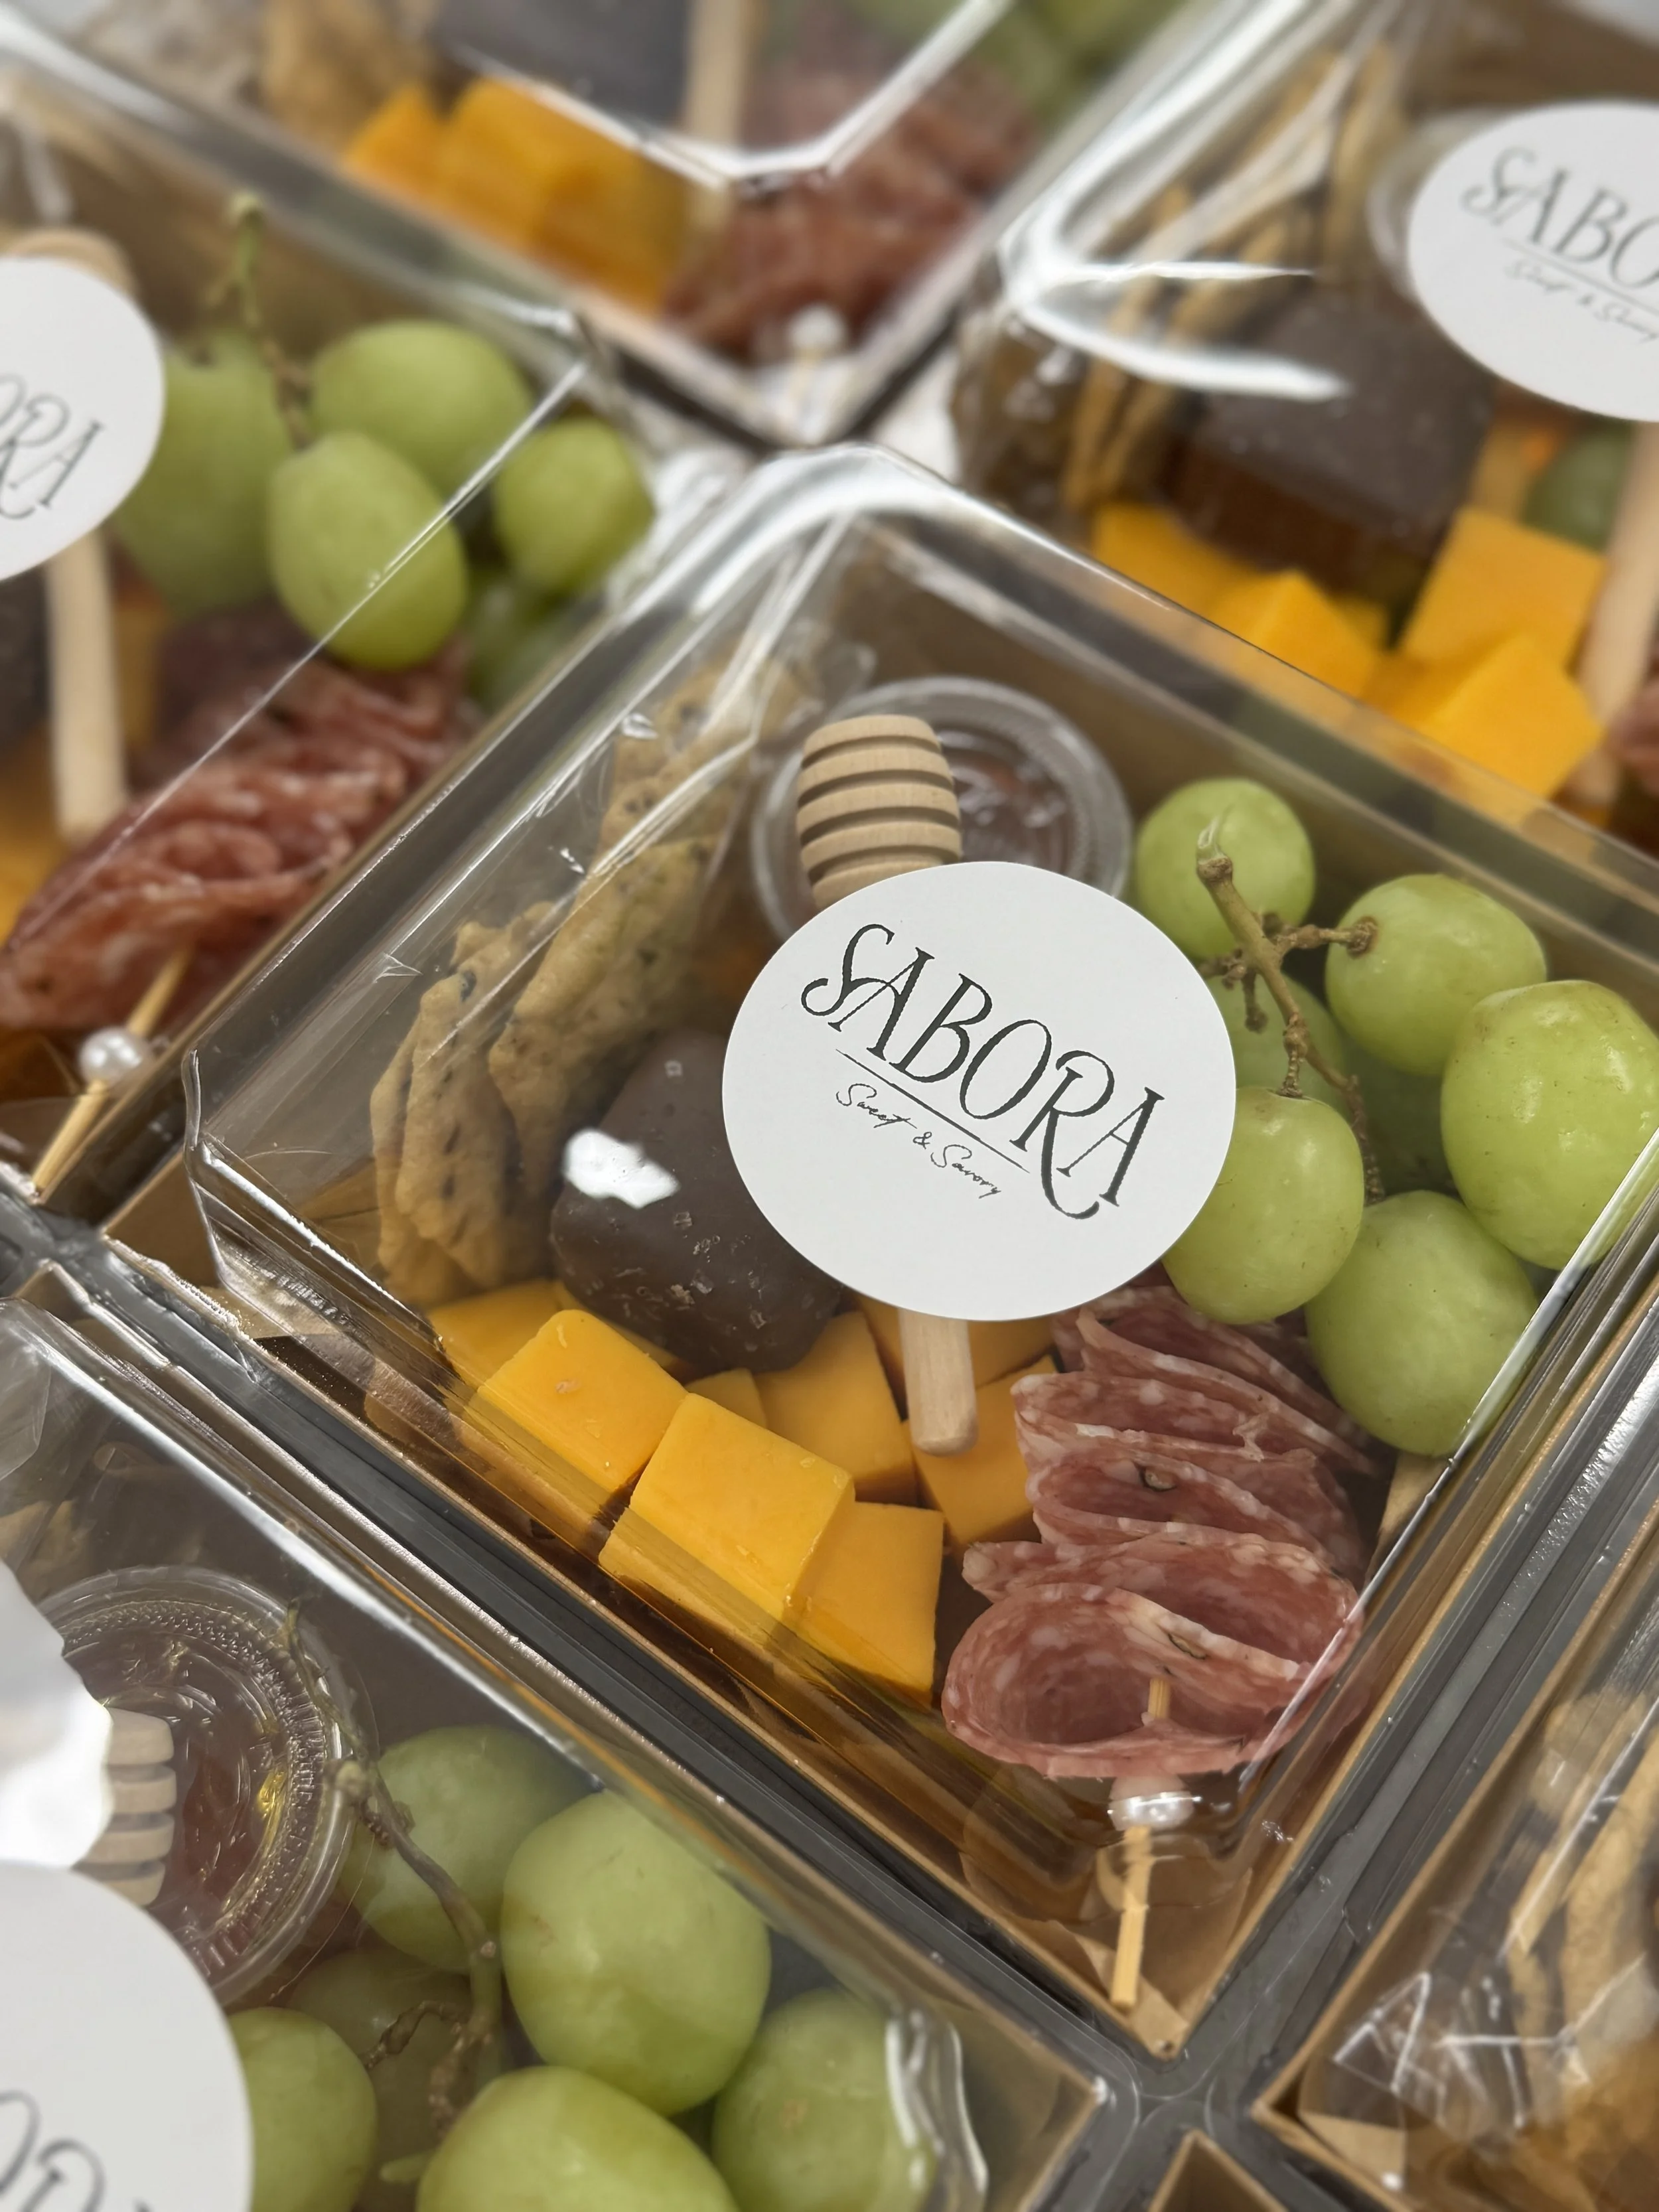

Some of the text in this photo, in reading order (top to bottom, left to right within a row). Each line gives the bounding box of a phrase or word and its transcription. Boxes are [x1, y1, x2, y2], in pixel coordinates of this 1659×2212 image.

[800, 923, 1165, 1220] SABORA
[835, 1082, 1001, 1199] Sweet & Savory
